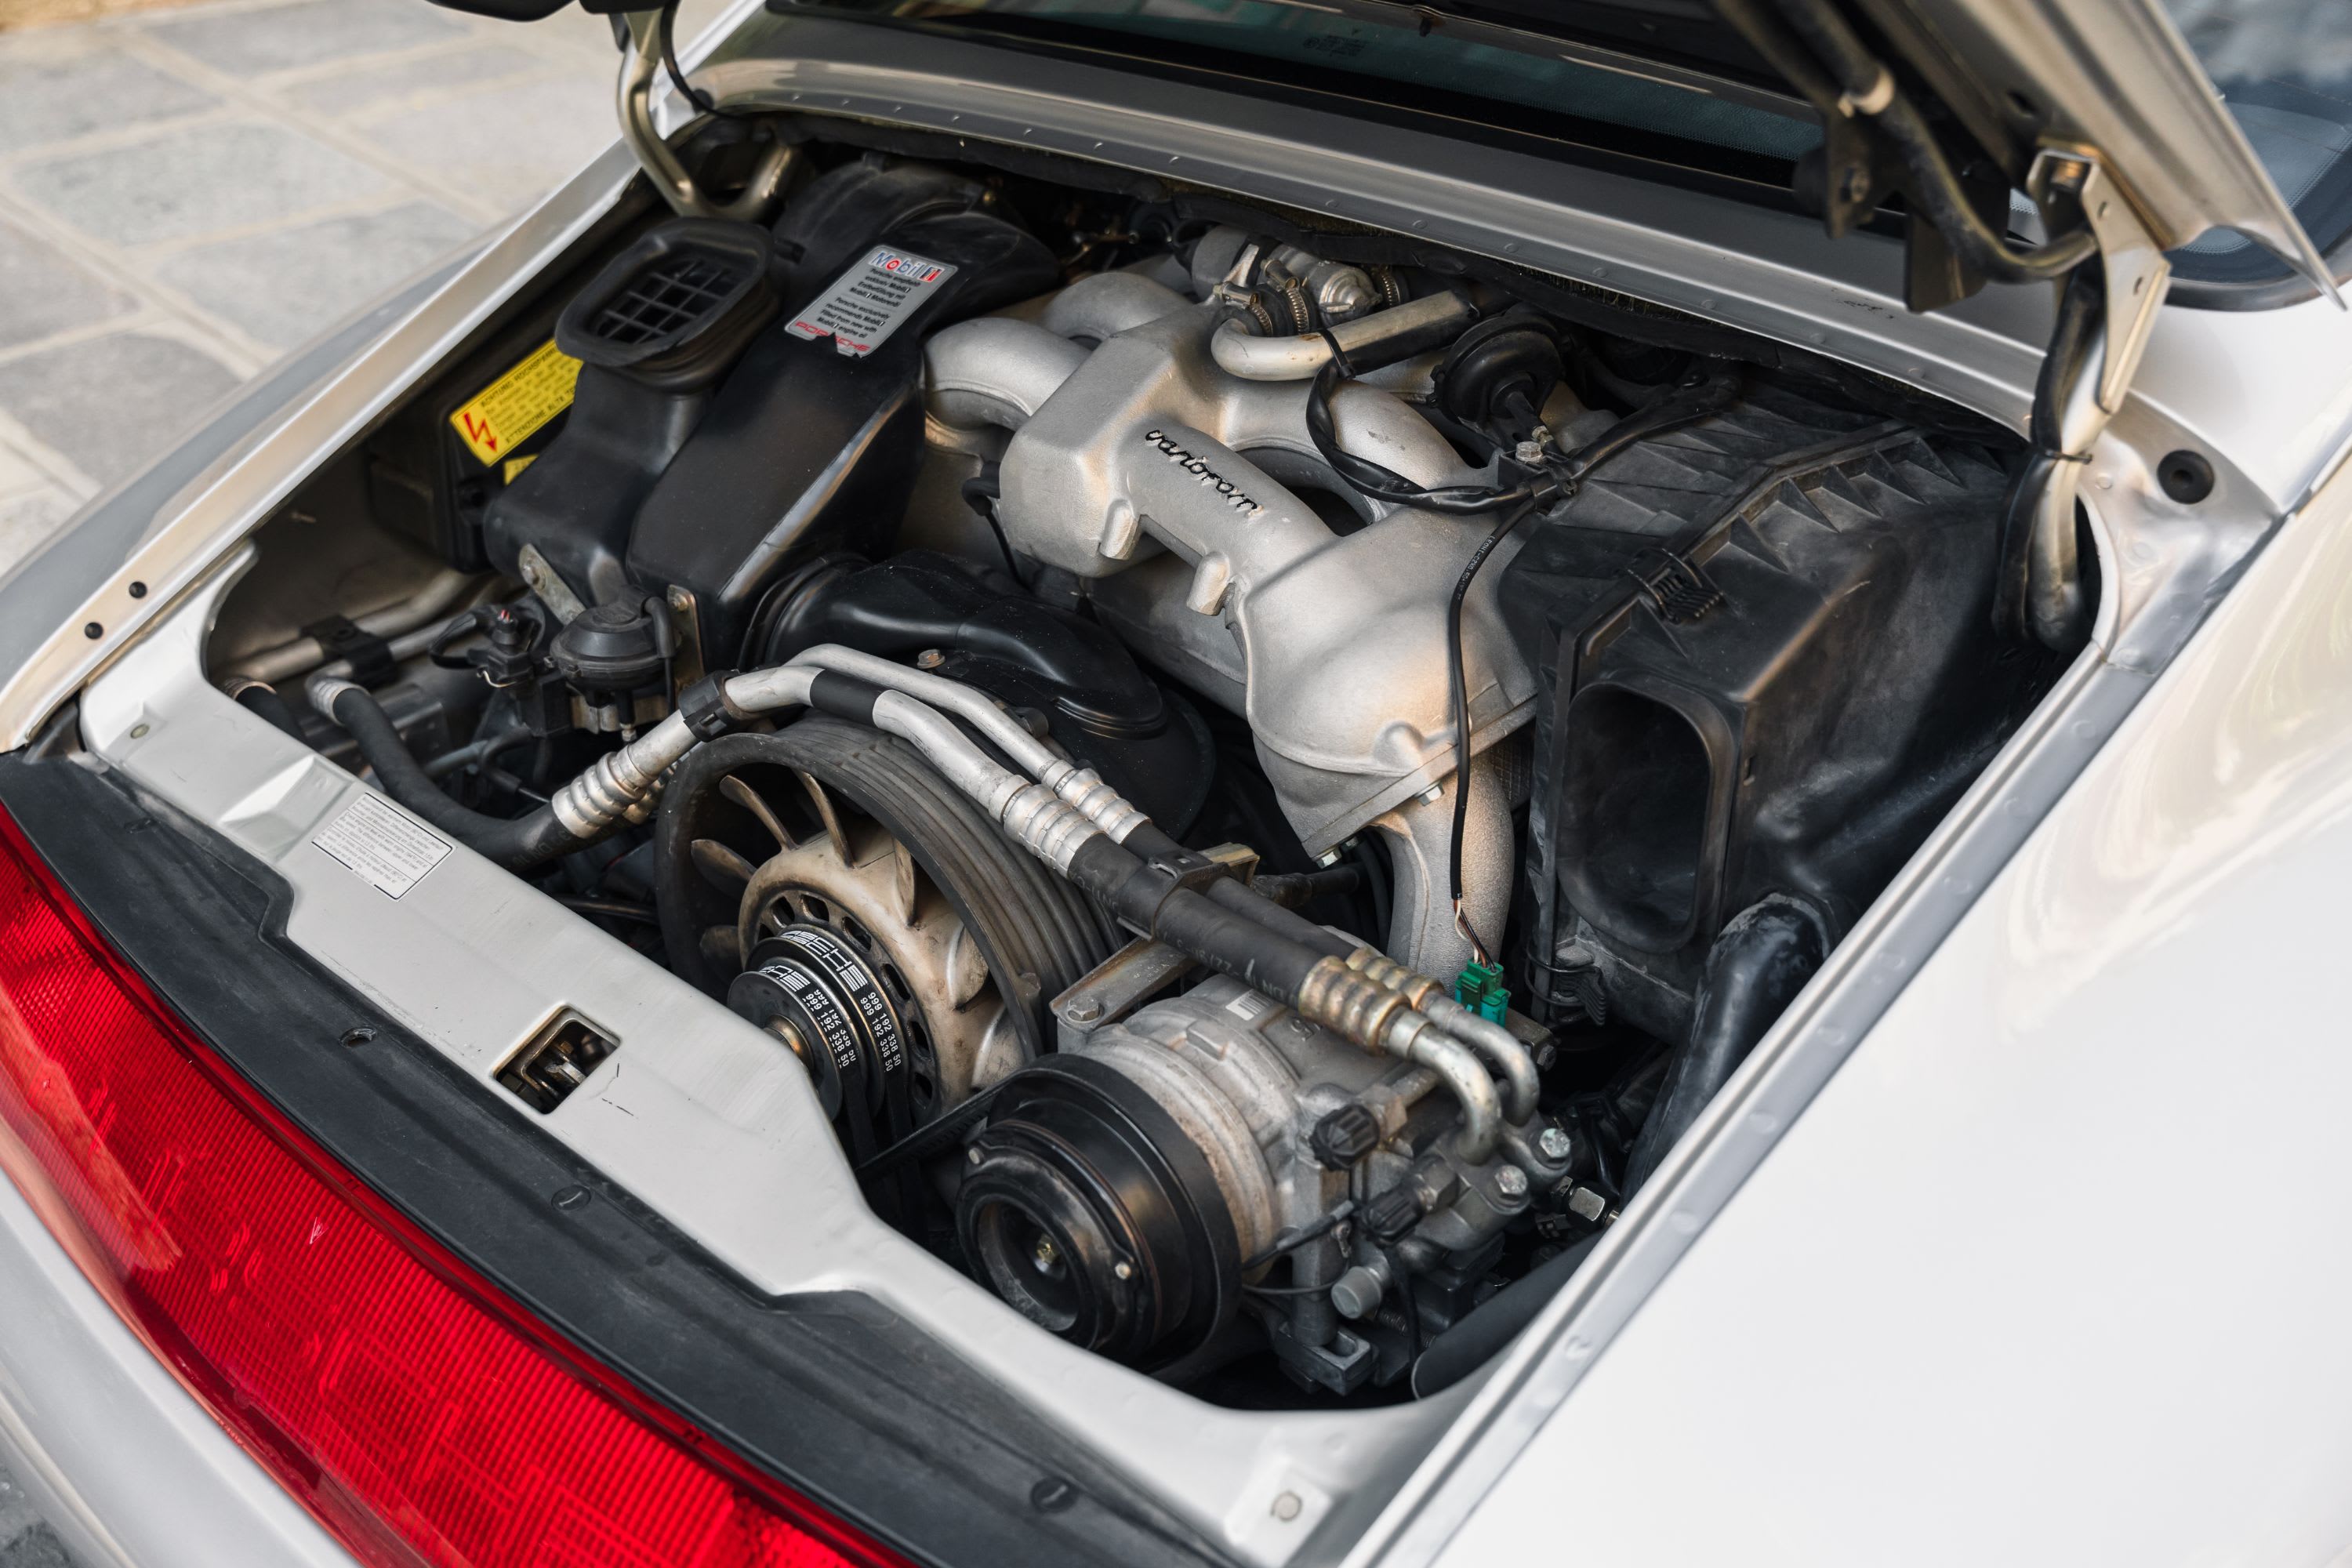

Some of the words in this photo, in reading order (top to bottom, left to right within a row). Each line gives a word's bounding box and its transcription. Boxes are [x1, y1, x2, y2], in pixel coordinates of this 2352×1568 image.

[869, 252, 925, 277] Mobil
[795, 321, 870, 351] PORCHE
[838, 326, 858, 336] engine
[861, 997, 874, 1016] 999
[805, 993, 822, 1010] 999
[821, 1012, 836, 1031] 192
[832, 1032, 844, 1051] 338
[840, 1054, 850, 1067] 50
[868, 992, 883, 1011] 999
[880, 1013, 892, 1032] 192
[887, 1033, 898, 1052] 338
[893, 1054, 902, 1066] 50
[872, 1018, 884, 1037] 192
[880, 1039, 891, 1058] 338
[885, 1059, 894, 1072] 50
